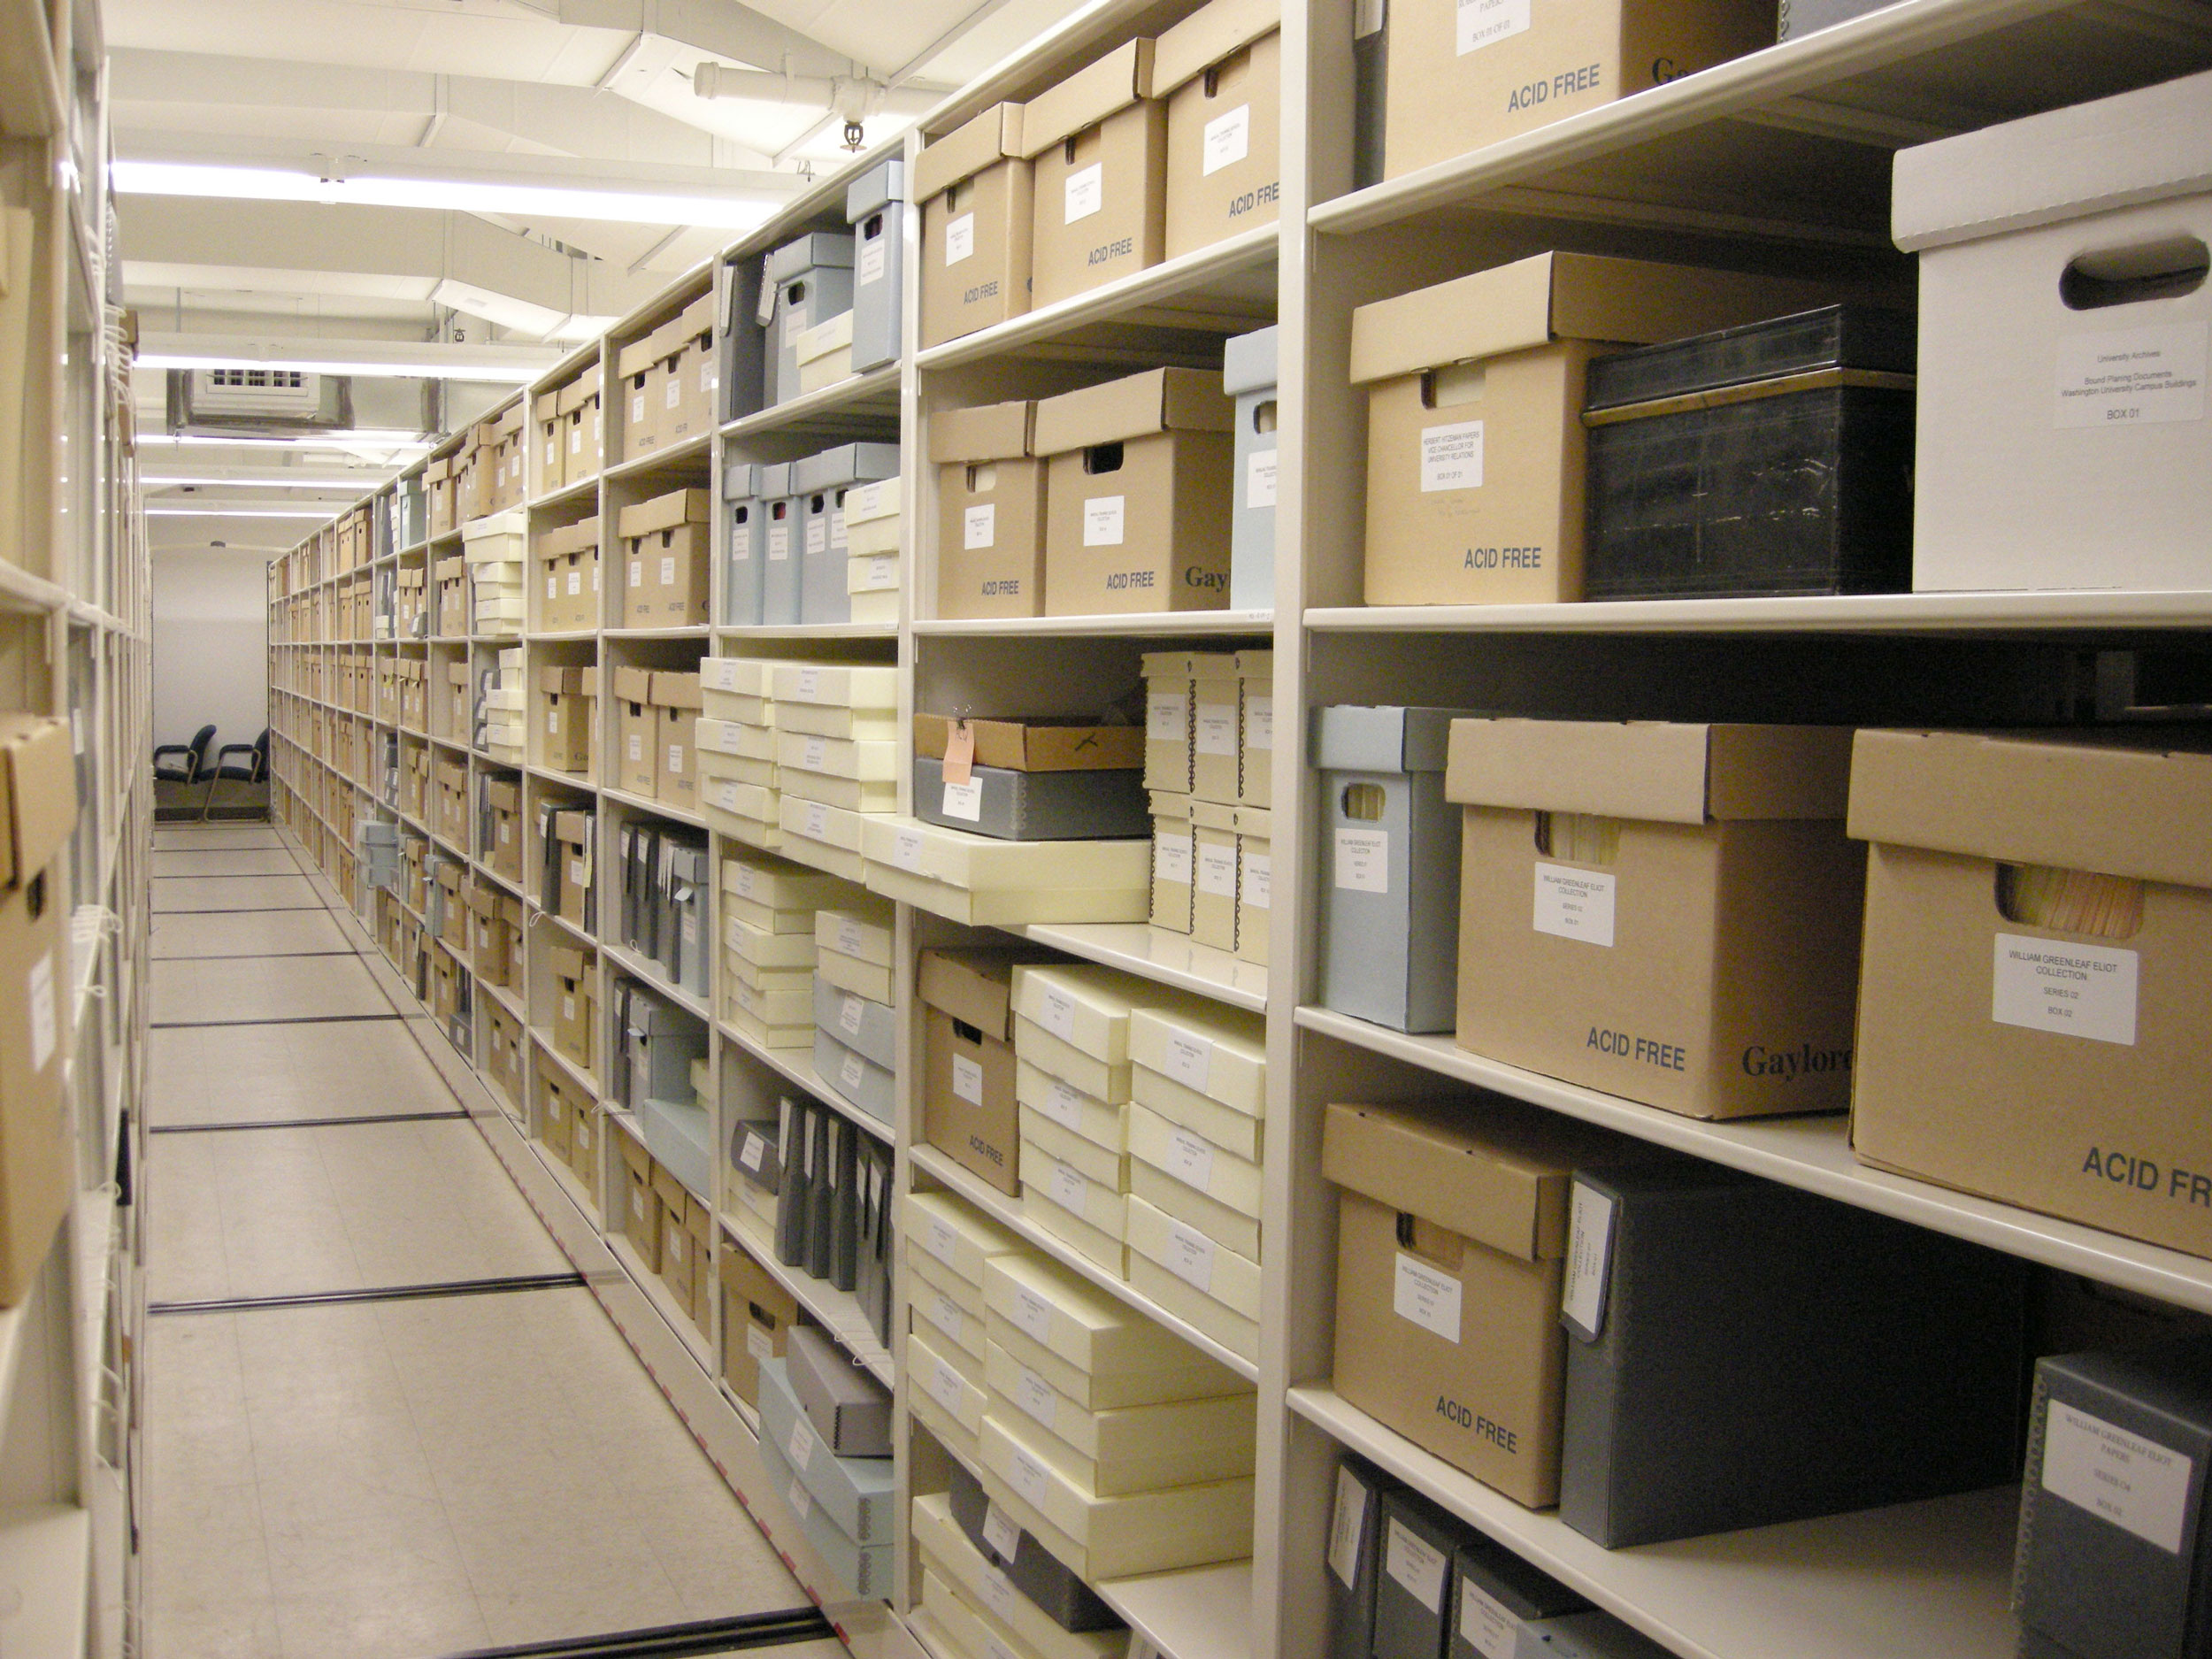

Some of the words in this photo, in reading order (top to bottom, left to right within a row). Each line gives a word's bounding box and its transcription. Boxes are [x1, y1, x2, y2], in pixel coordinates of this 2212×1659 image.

[1507, 81, 1548, 112] ACID
[1553, 63, 1601, 99] FREE
[1229, 192, 1254, 219] ACID
[1088, 246, 1108, 266] ACID
[1110, 237, 1133, 258] FREE
[964, 288, 979, 305] ACID
[979, 280, 998, 299] FREE
[2097, 353, 2130, 363] University
[2131, 350, 2161, 359] Archives
[2061, 388, 2100, 397] Washington
[2101, 384, 2132, 395] University
[2134, 381, 2163, 391] Campus
[2164, 379, 2197, 388] Buildings
[2085, 376, 2105, 385] Bound
[2133, 371, 2172, 381] Documents
[2107, 410, 2126, 420] BOX
[2129, 408, 2139, 419] 01
[1464, 549, 1498, 569] ACID
[1502, 547, 1541, 568] FREE
[981, 581, 997, 595] ACID
[999, 580, 1019, 595] FREE
[1106, 573, 1127, 589] ACID
[1130, 571, 1155, 588] FREE
[1186, 566, 1231, 593] Gay
[1558, 887, 1587, 898] COLLECTION
[2008, 949, 2041, 962] WILLIAM
[2042, 955, 2091, 969] GREENLEAF
[2093, 962, 2117, 972] ELIOT
[2036, 966, 2087, 980] COLLECTION
[2043, 987, 2069, 998] SERIES
[2047, 1006, 2062, 1017] BOX
[1586, 1026, 1630, 1056] ACID
[1636, 1038, 1686, 1071] FREE
[2082, 1147, 2159, 1190] ACID
[2170, 1169, 2212, 1208] FR
[1437, 1395, 1471, 1428] ACID
[1476, 1416, 1517, 1454] FREE
[2065, 1415, 2100, 1436] WILLIAM
[2101, 1430, 2147, 1455] GREENLEAF
[2101, 1443, 2130, 1463] PAPERS
[2093, 1469, 2118, 1486] SERIES
